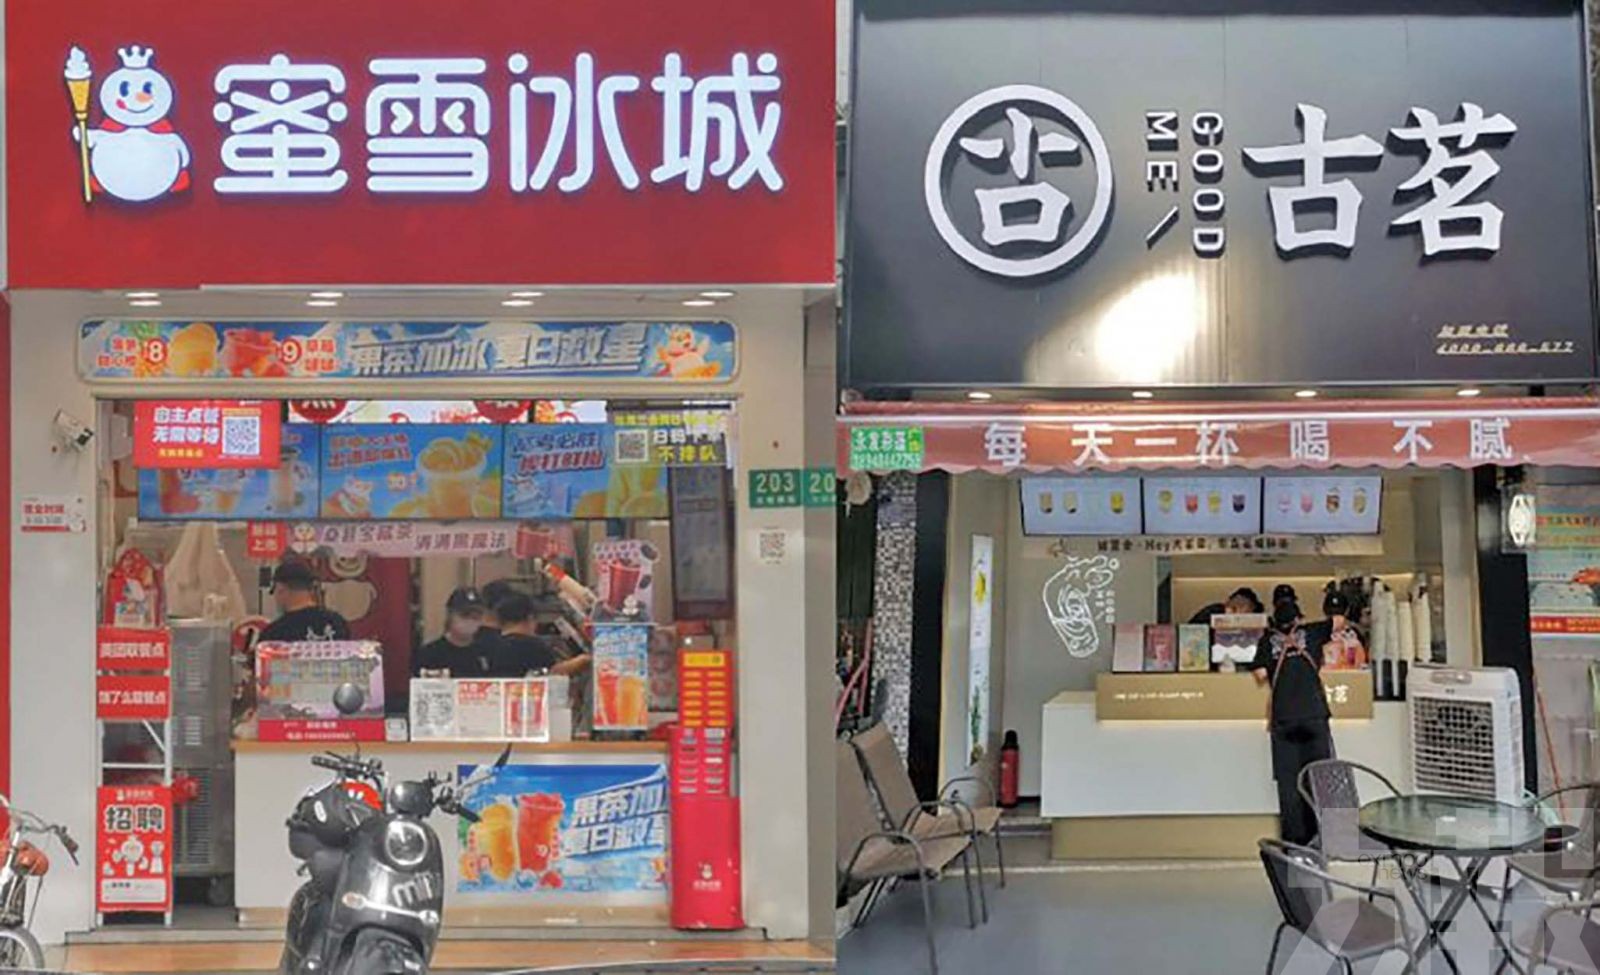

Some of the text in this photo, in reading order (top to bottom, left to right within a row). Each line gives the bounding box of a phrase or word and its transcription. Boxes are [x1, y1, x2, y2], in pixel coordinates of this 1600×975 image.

[213, 53, 784, 193] 蜜雪冰城
[1193, 112, 1224, 257] GOOD
[1243, 103, 1517, 257] 古茗
[283, 341, 298, 362] 9
[756, 472, 794, 493] 203
[105, 805, 165, 833] 招聘
